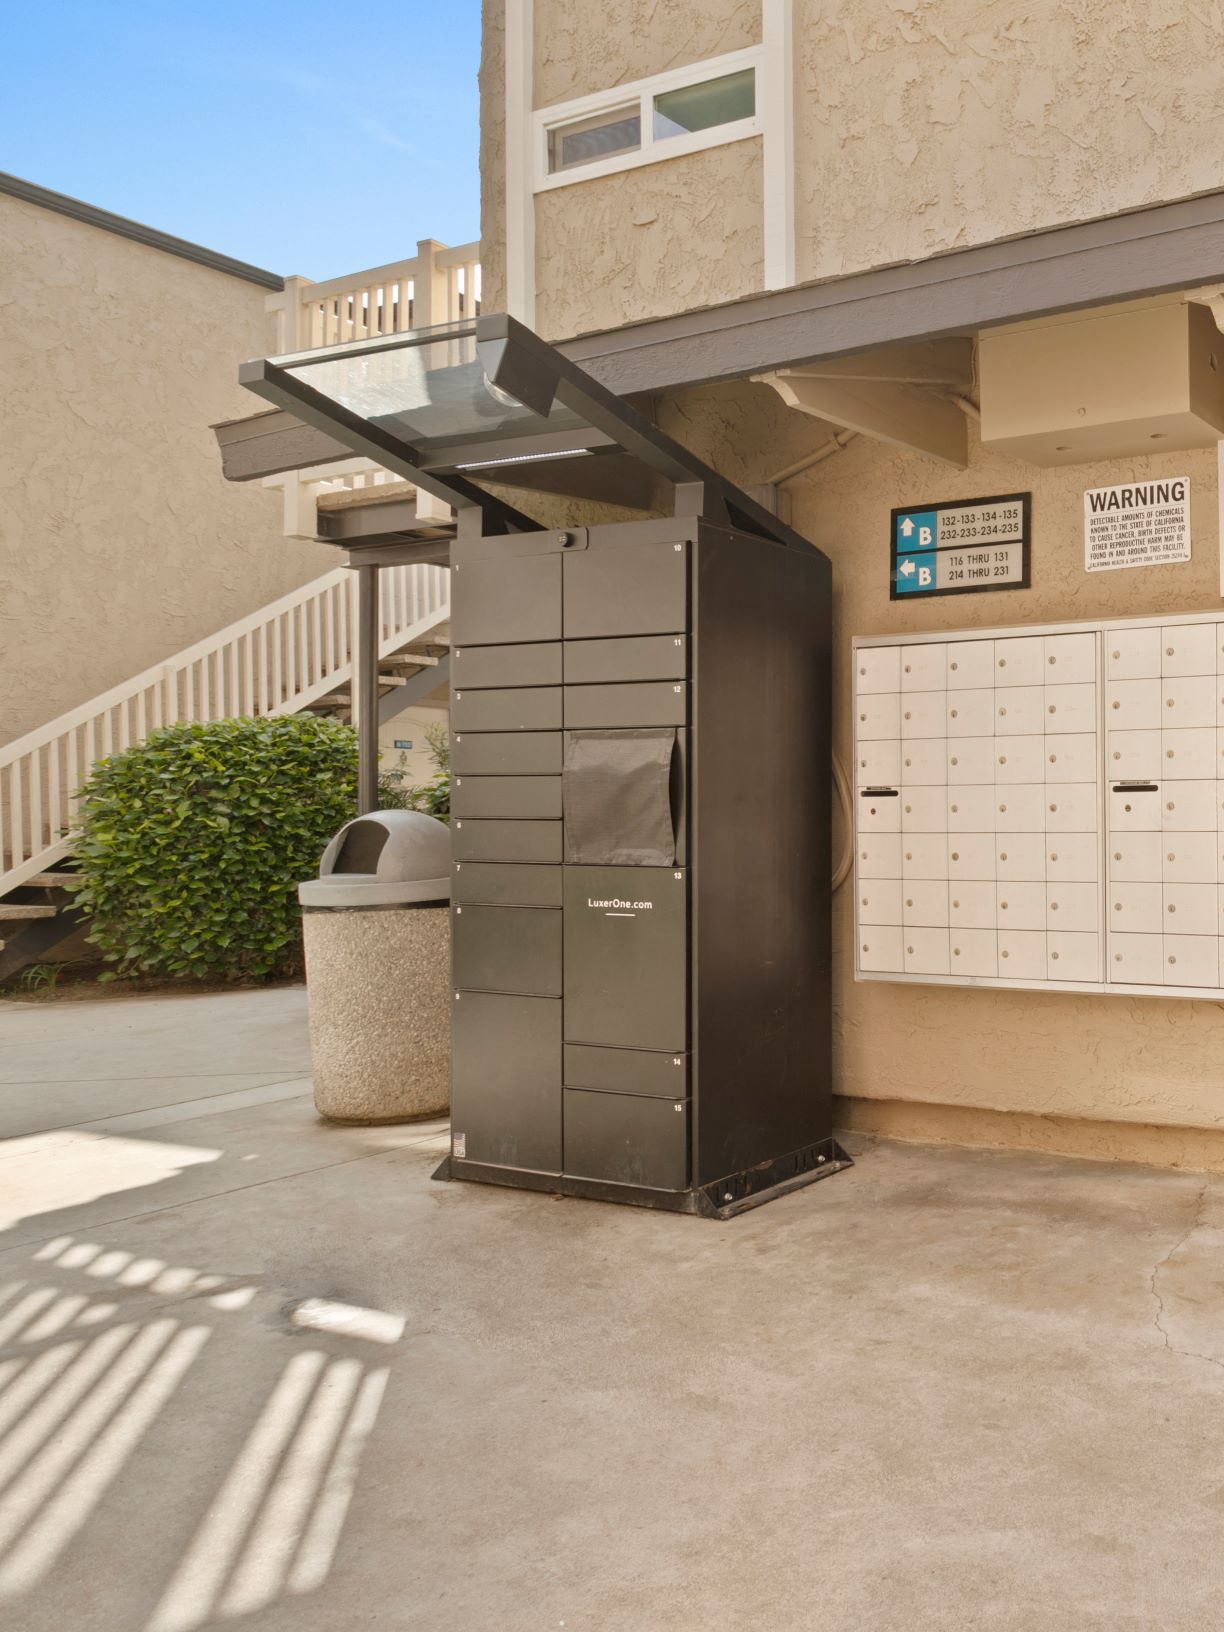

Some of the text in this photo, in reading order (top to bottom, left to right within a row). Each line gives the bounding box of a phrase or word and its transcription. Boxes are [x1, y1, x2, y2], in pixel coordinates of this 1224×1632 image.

[1089, 481, 1185, 513] WARNING
[1090, 516, 1119, 525] DETECTABLE
[1121, 513, 1145, 521] AMOUNTS
[1155, 507, 1184, 517] CHEMICALS
[1091, 526, 1109, 534] KNOWN
[1154, 516, 1184, 526] CALIFORNIA
[919, 526, 932, 546] B
[1098, 534, 1113, 542] CAUSE
[1138, 529, 1153, 537] BIRTH
[1155, 526, 1176, 535] DEFECTS
[1110, 539, 1146, 549] REPRODUCTIVE
[949, 551, 1009, 566] 116 THRU 131
[1090, 552, 1106, 560] FOUND
[1128, 547, 1148, 555] AROUND
[918, 567, 932, 586] B
[949, 565, 1009, 581] 214 THRU 231
[673, 685, 681, 693] 12
[673, 872, 682, 880] 13
[587, 898, 653, 909] LuxerOne.com
[673, 1057, 681, 1066] 14
[673, 1104, 682, 1112] 15
